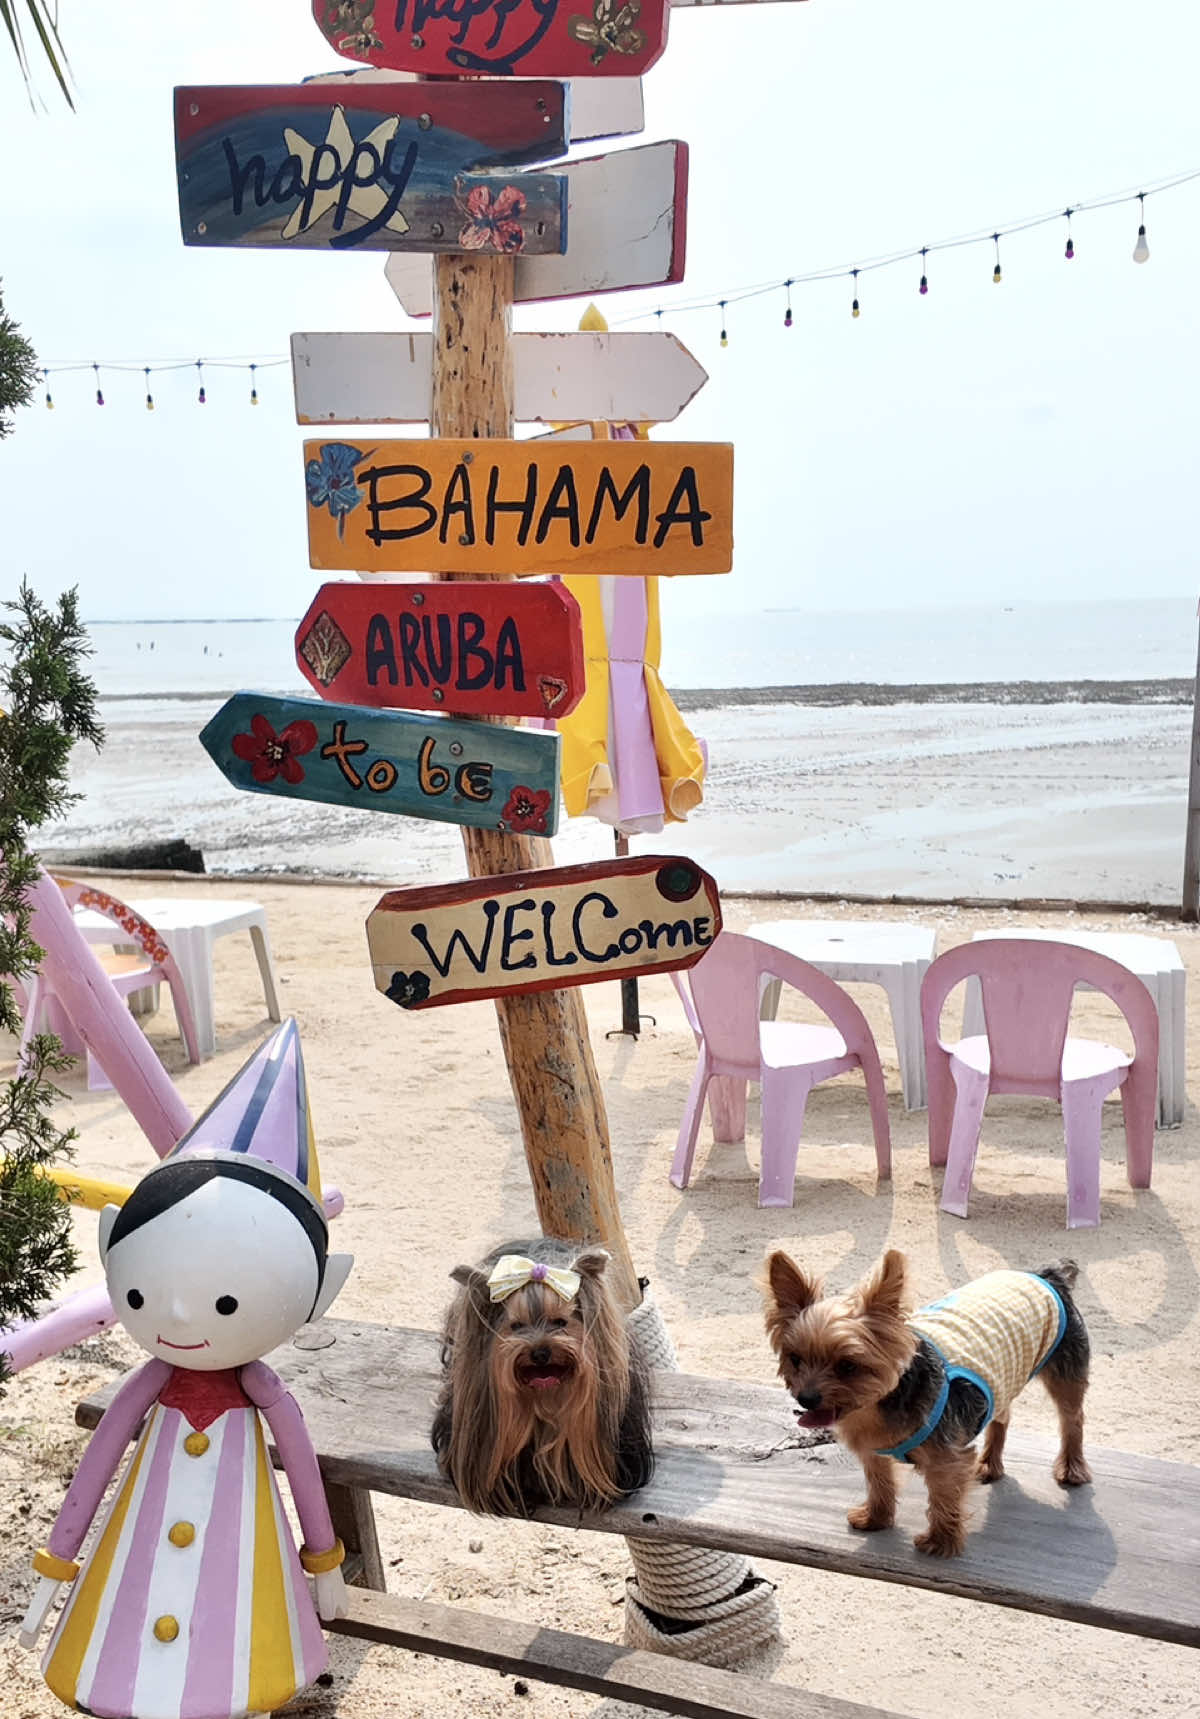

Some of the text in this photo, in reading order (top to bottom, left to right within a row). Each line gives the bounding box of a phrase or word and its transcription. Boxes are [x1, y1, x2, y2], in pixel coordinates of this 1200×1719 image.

[224, 137, 418, 246] happy
[357, 463, 711, 547] BAHAMA
[366, 612, 526, 692] ARUBA
[320, 720, 397, 791] to
